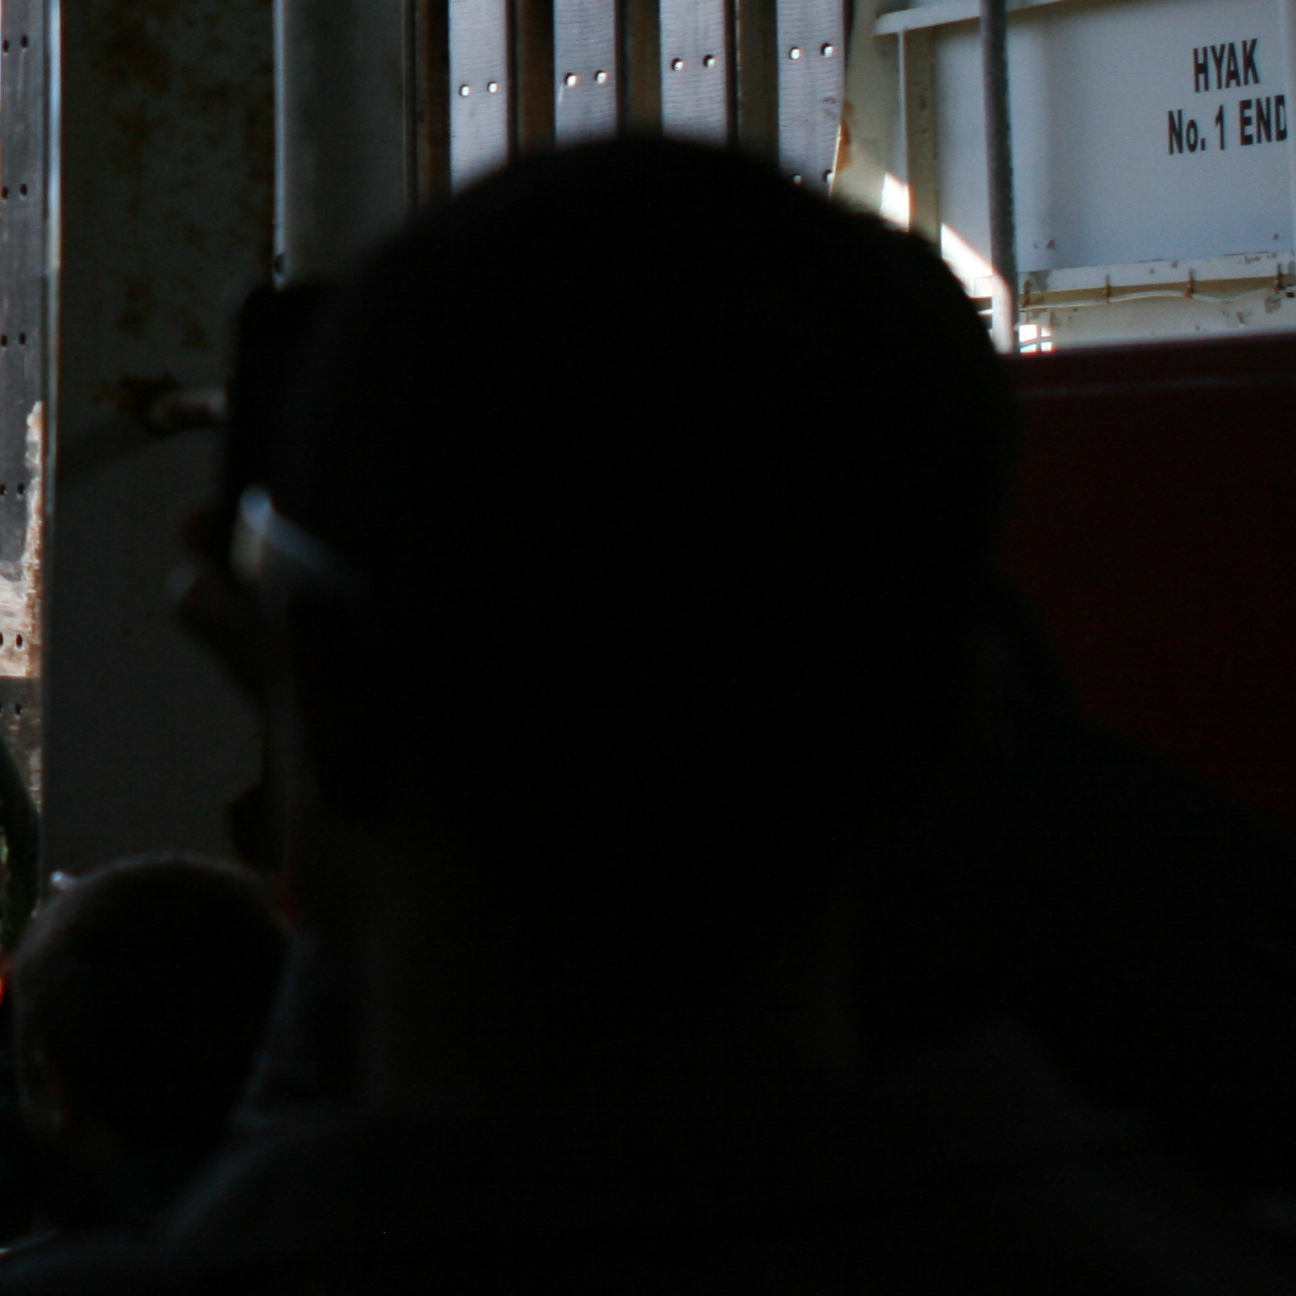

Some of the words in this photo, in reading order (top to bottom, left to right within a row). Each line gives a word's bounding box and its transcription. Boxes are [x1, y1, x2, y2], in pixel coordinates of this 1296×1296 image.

[1192, 37, 1261, 94] HYAK
[1167, 108, 1206, 156] No.
[1214, 104, 1226, 151] 1
[1238, 93, 1288, 147] END
